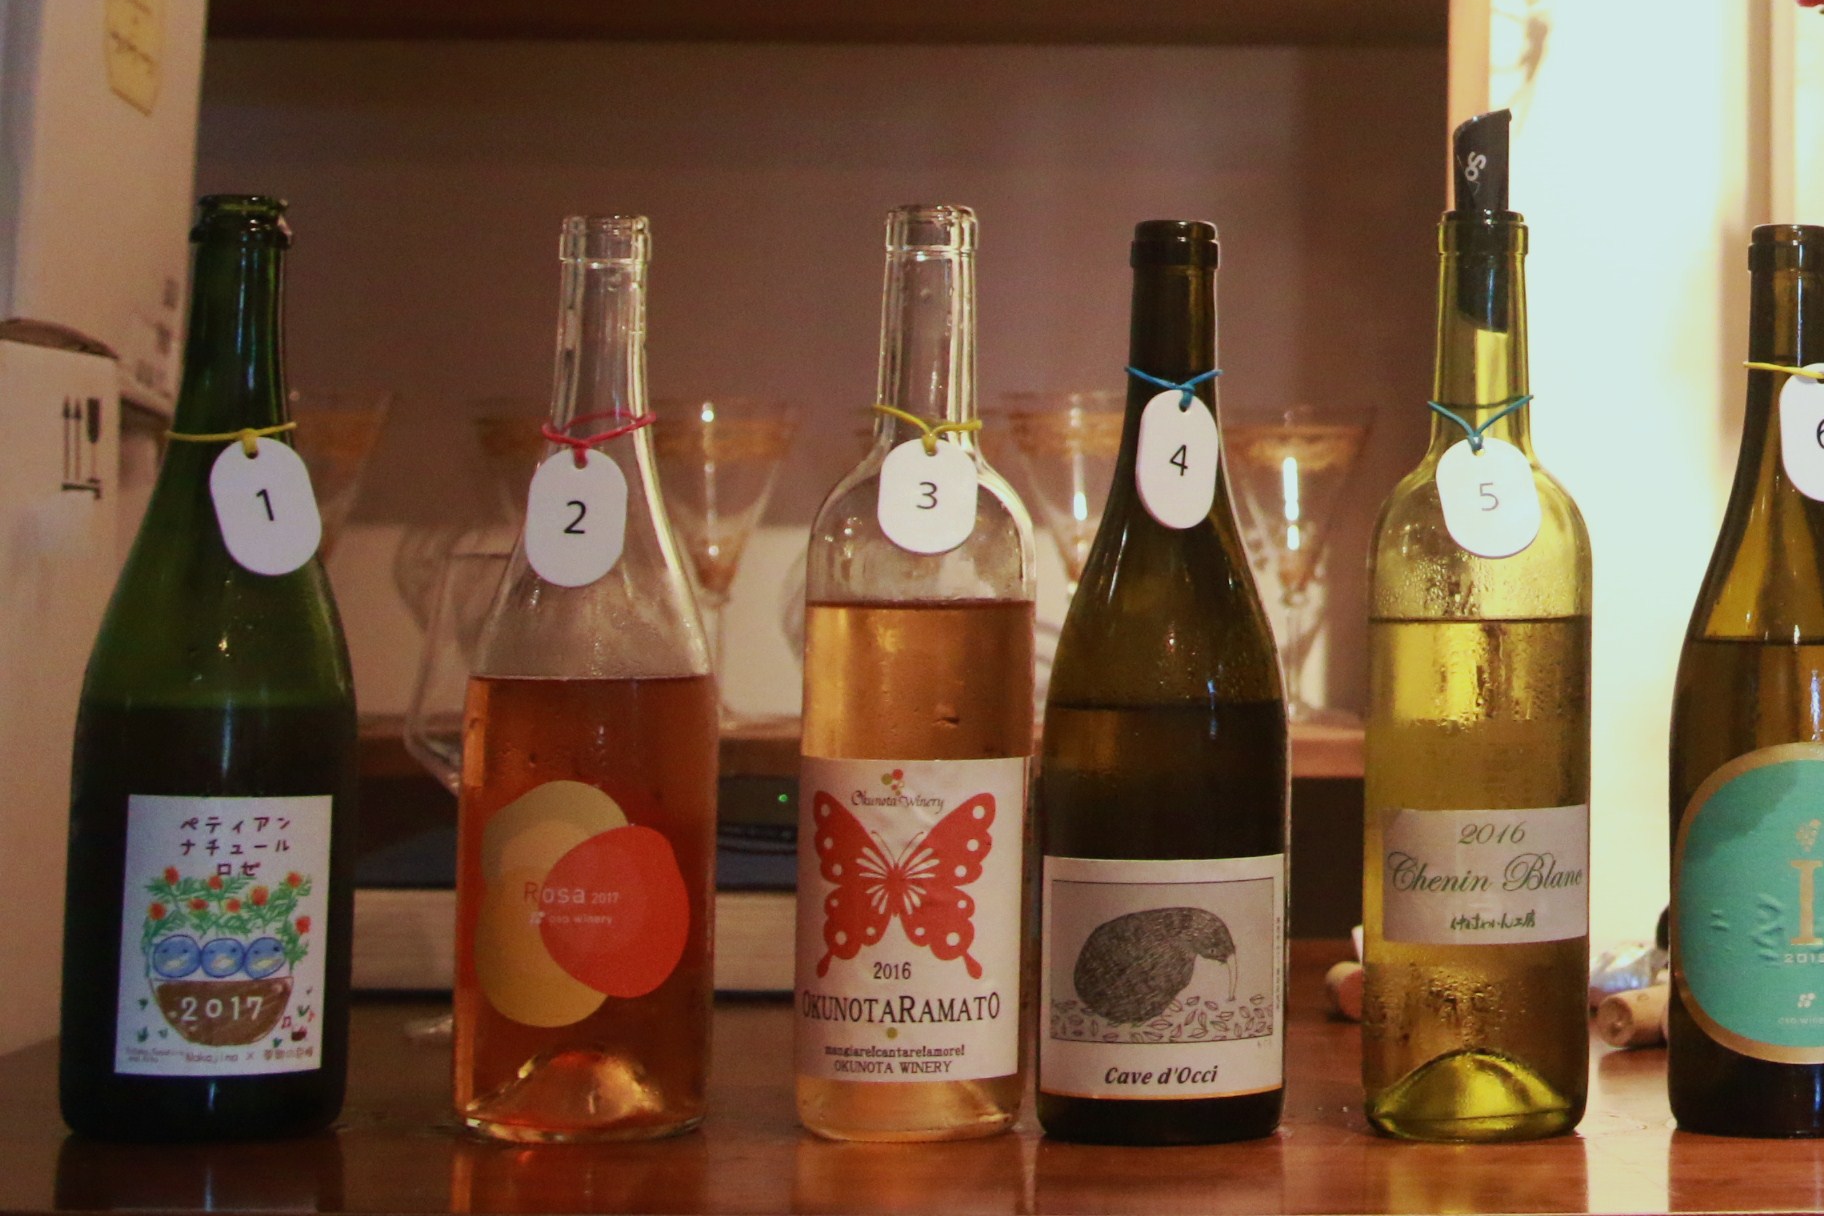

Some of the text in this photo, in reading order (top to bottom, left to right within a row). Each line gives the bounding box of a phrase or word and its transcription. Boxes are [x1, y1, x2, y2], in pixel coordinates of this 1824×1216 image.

[1168, 444, 1189, 478] 4
[254, 489, 275, 522] 1
[916, 481, 938, 510] 3
[1479, 482, 1500, 512] 5
[563, 500, 587, 534] 2
[898, 792, 945, 815] Winery
[180, 816, 291, 834] ペティアン
[1457, 821, 1527, 845] 2016
[180, 839, 291, 856] ナチュール
[216, 861, 261, 877] ロゼ
[1387, 851, 1583, 892] Chenin Blanc
[523, 881, 620, 905] Rosa 2017
[873, 961, 912, 981] 2016
[180, 995, 264, 1023] 2017
[833, 1059, 953, 1075] OKUNOTA WINERY
[1104, 1065, 1219, 1085] Cave d'Occi
